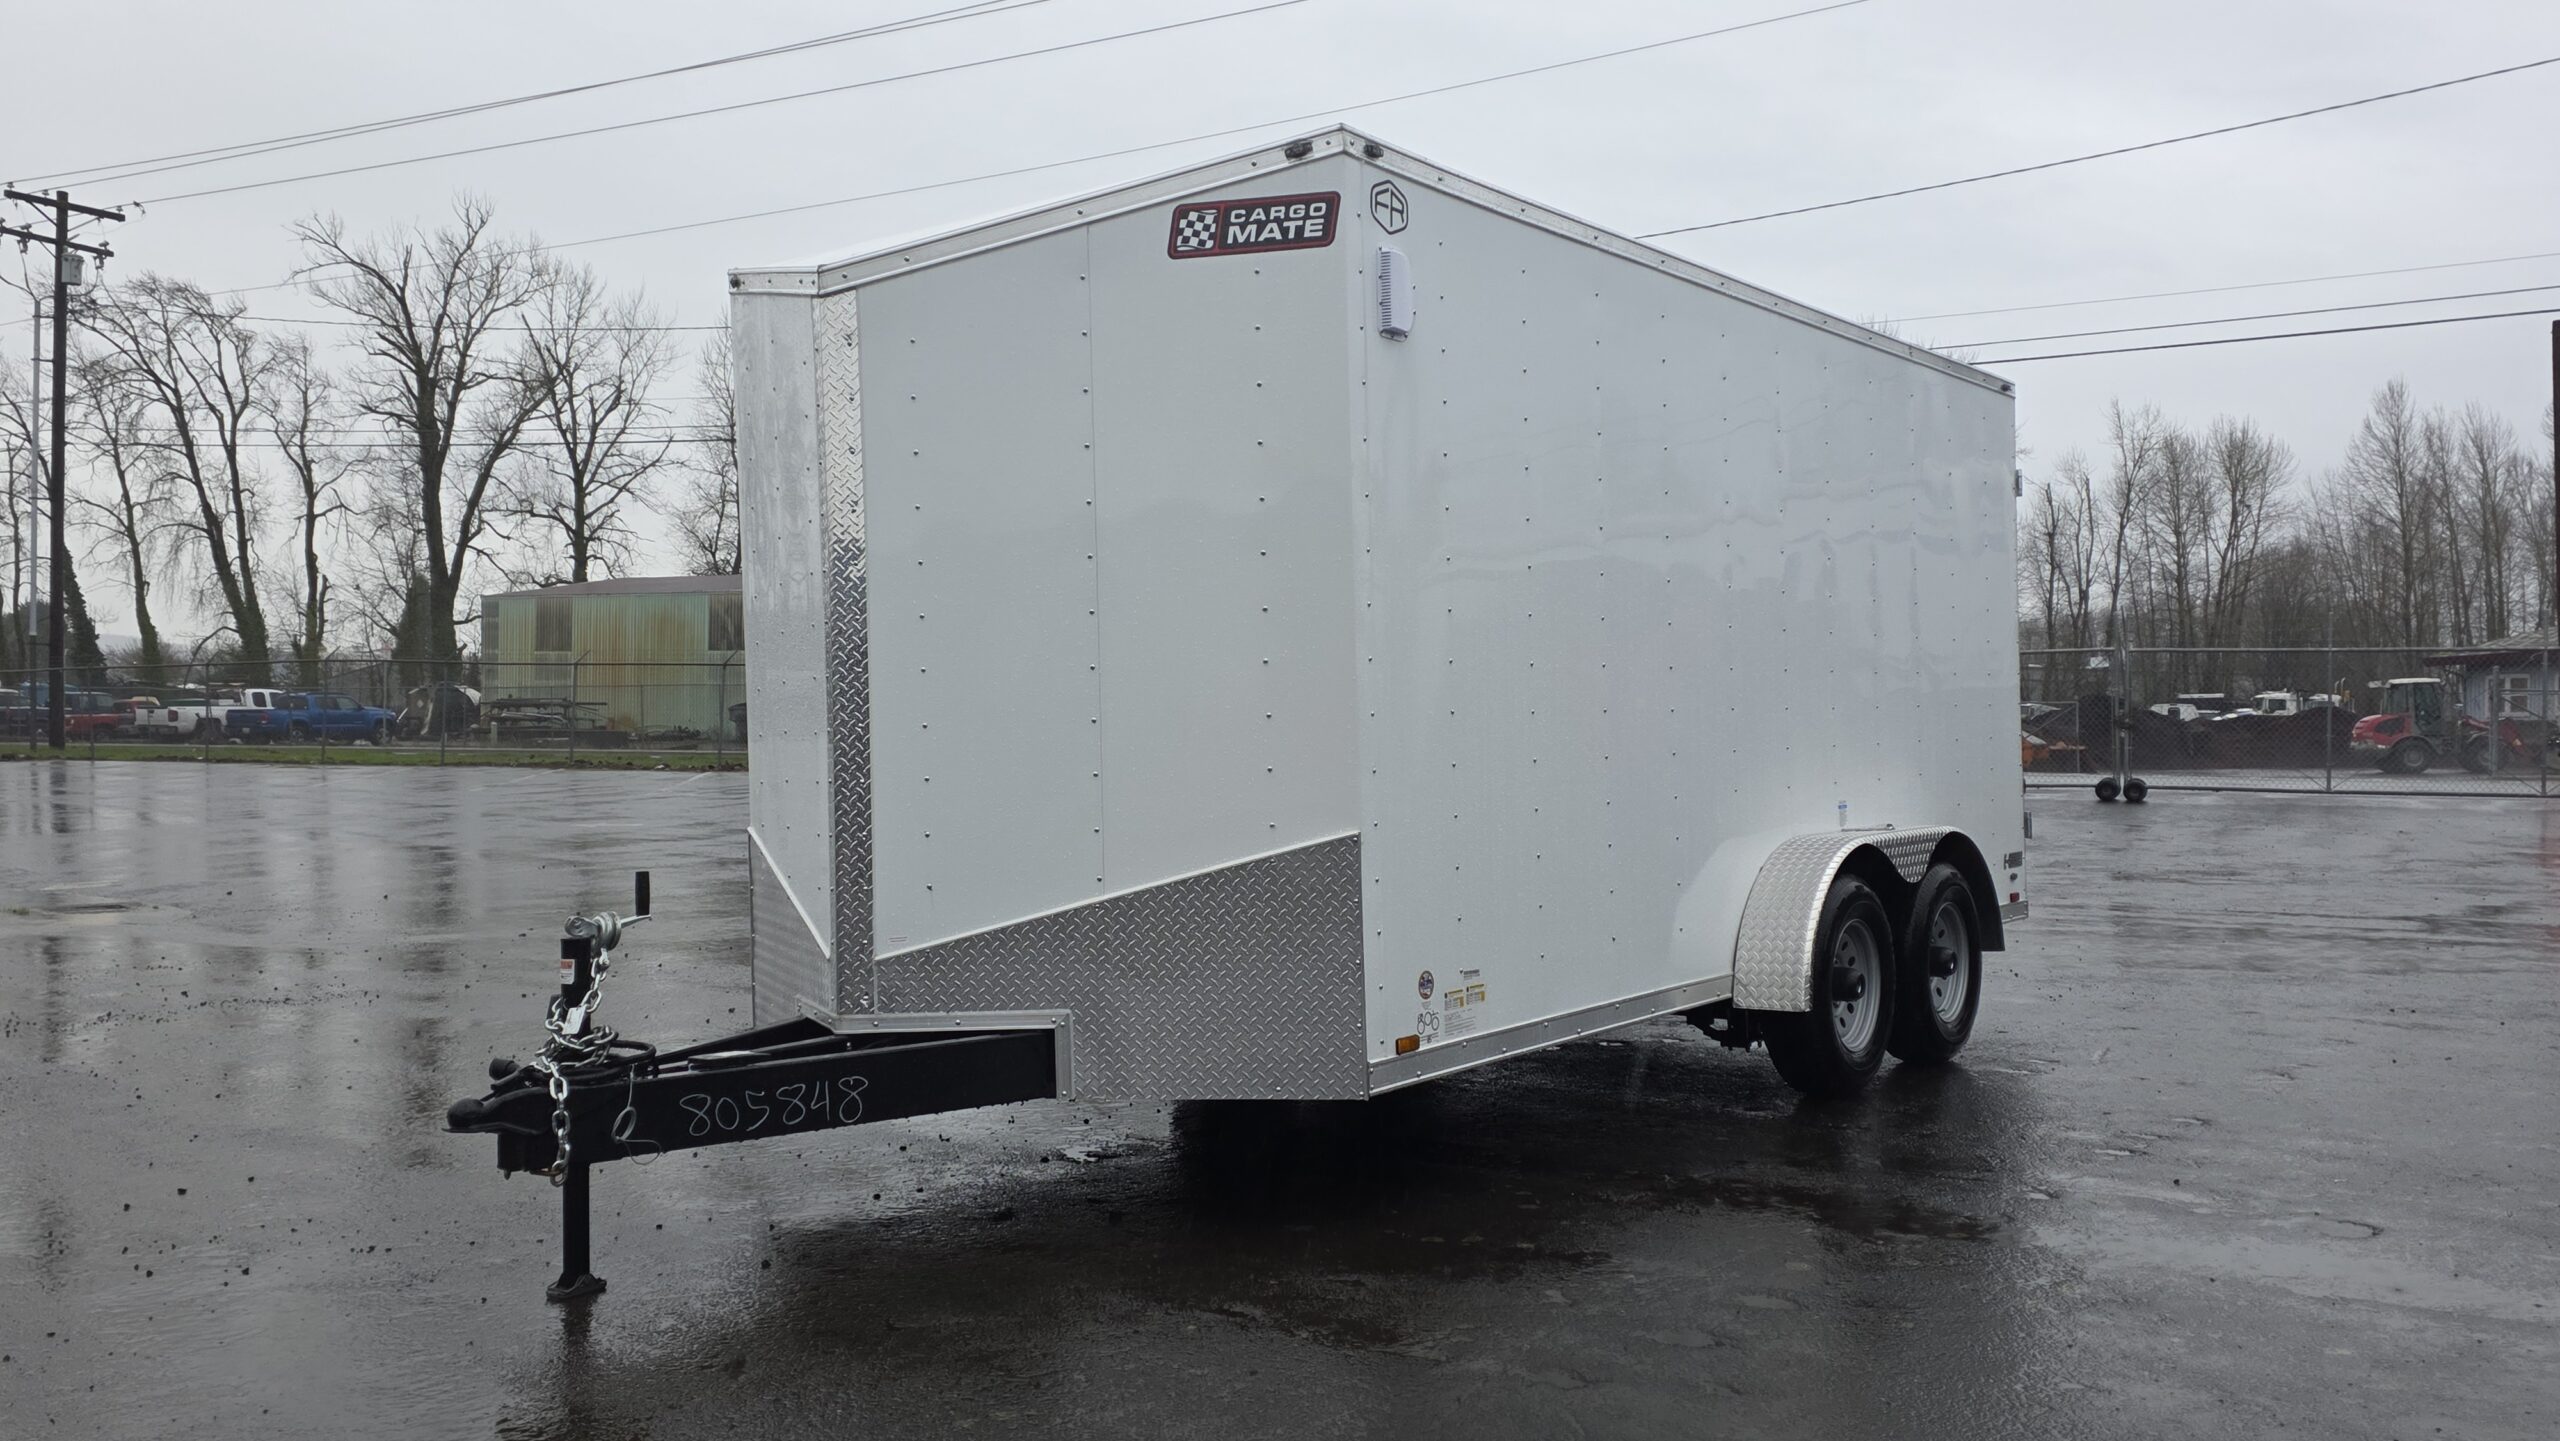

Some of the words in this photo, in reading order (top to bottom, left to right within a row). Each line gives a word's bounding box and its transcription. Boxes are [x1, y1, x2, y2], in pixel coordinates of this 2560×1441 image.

[1230, 202, 1326, 223] CARGO
[1227, 218, 1324, 244] MATE
[680, 1076, 868, 1136] 805848
